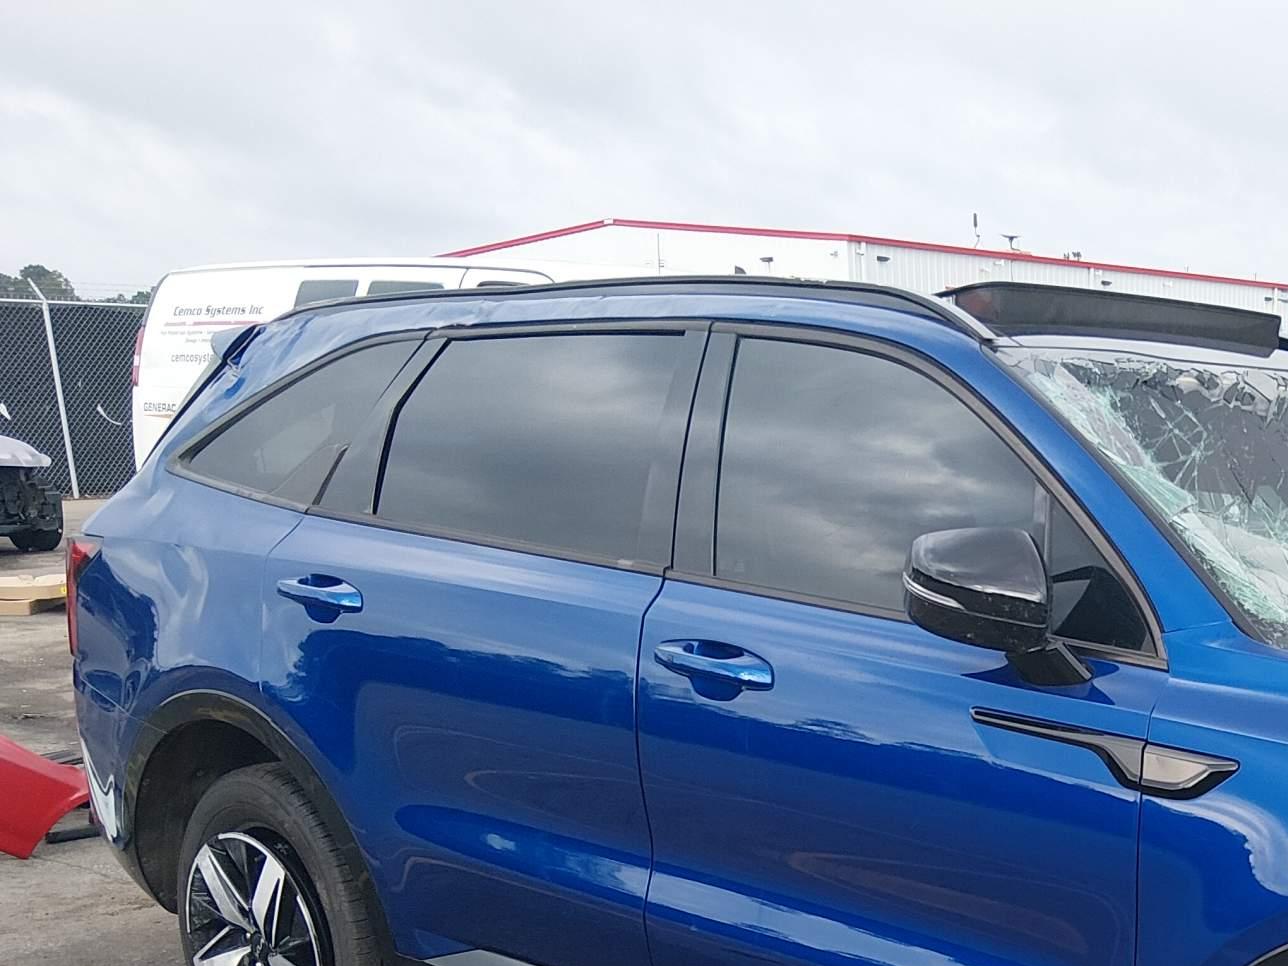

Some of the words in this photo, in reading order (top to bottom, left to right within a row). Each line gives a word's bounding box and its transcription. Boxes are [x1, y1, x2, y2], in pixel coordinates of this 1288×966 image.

[173, 306, 202, 317] Cemco
[205, 305, 246, 318] Systems
[248, 304, 264, 315] Inc
